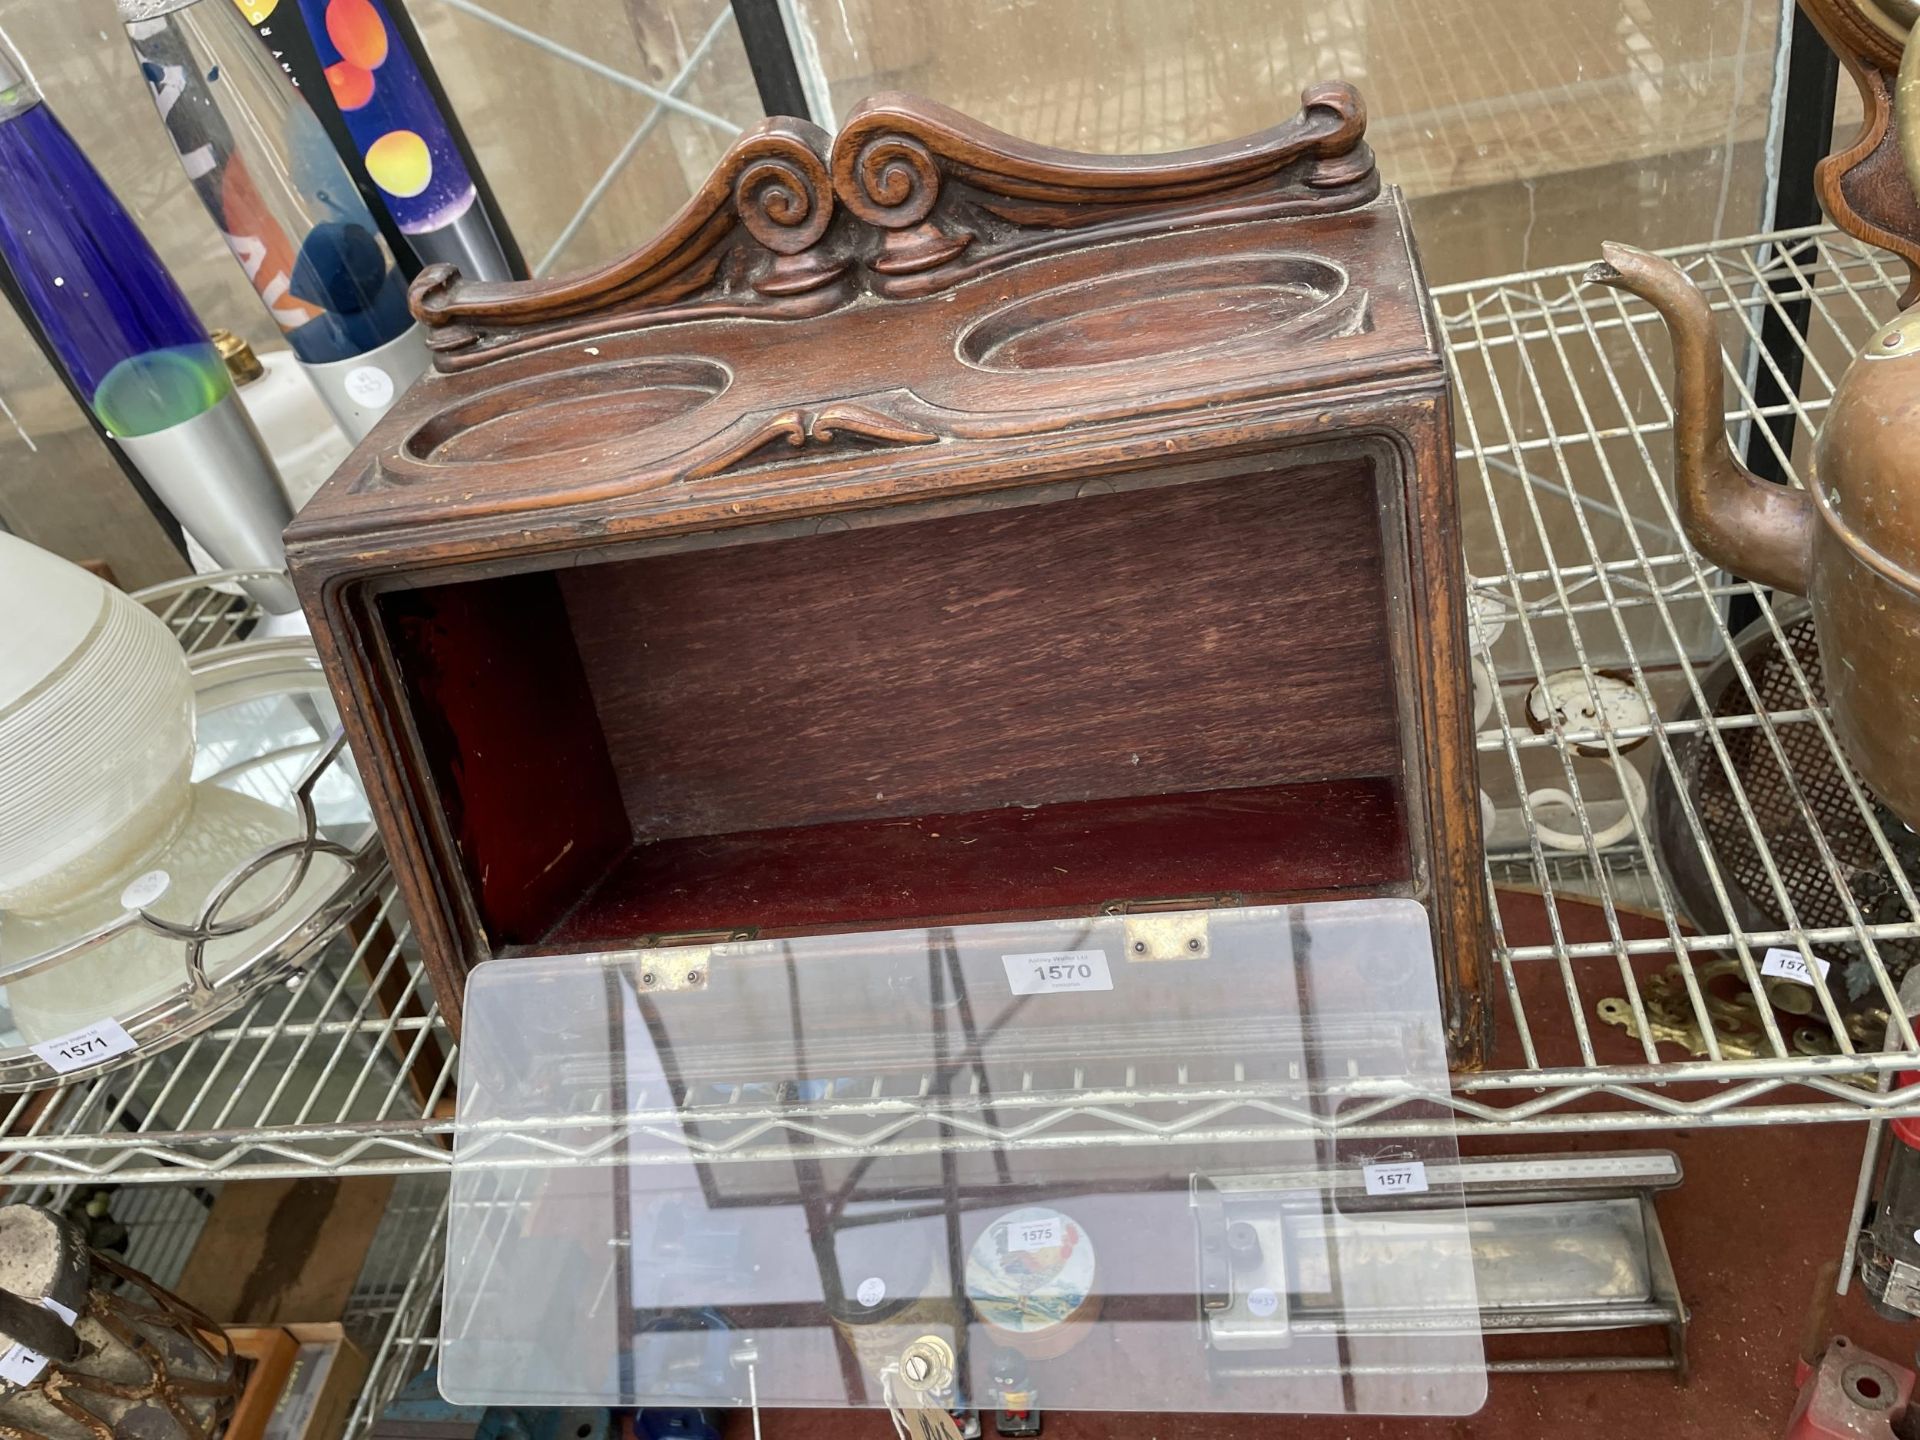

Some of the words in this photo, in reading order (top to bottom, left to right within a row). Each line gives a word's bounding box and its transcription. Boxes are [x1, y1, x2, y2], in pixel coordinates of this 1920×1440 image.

[1034, 964, 1092, 980] 1570
[60, 1037, 108, 1059] 1571
[1377, 1173, 1412, 1186] 1577
[1022, 1228, 1053, 1241] 1575
